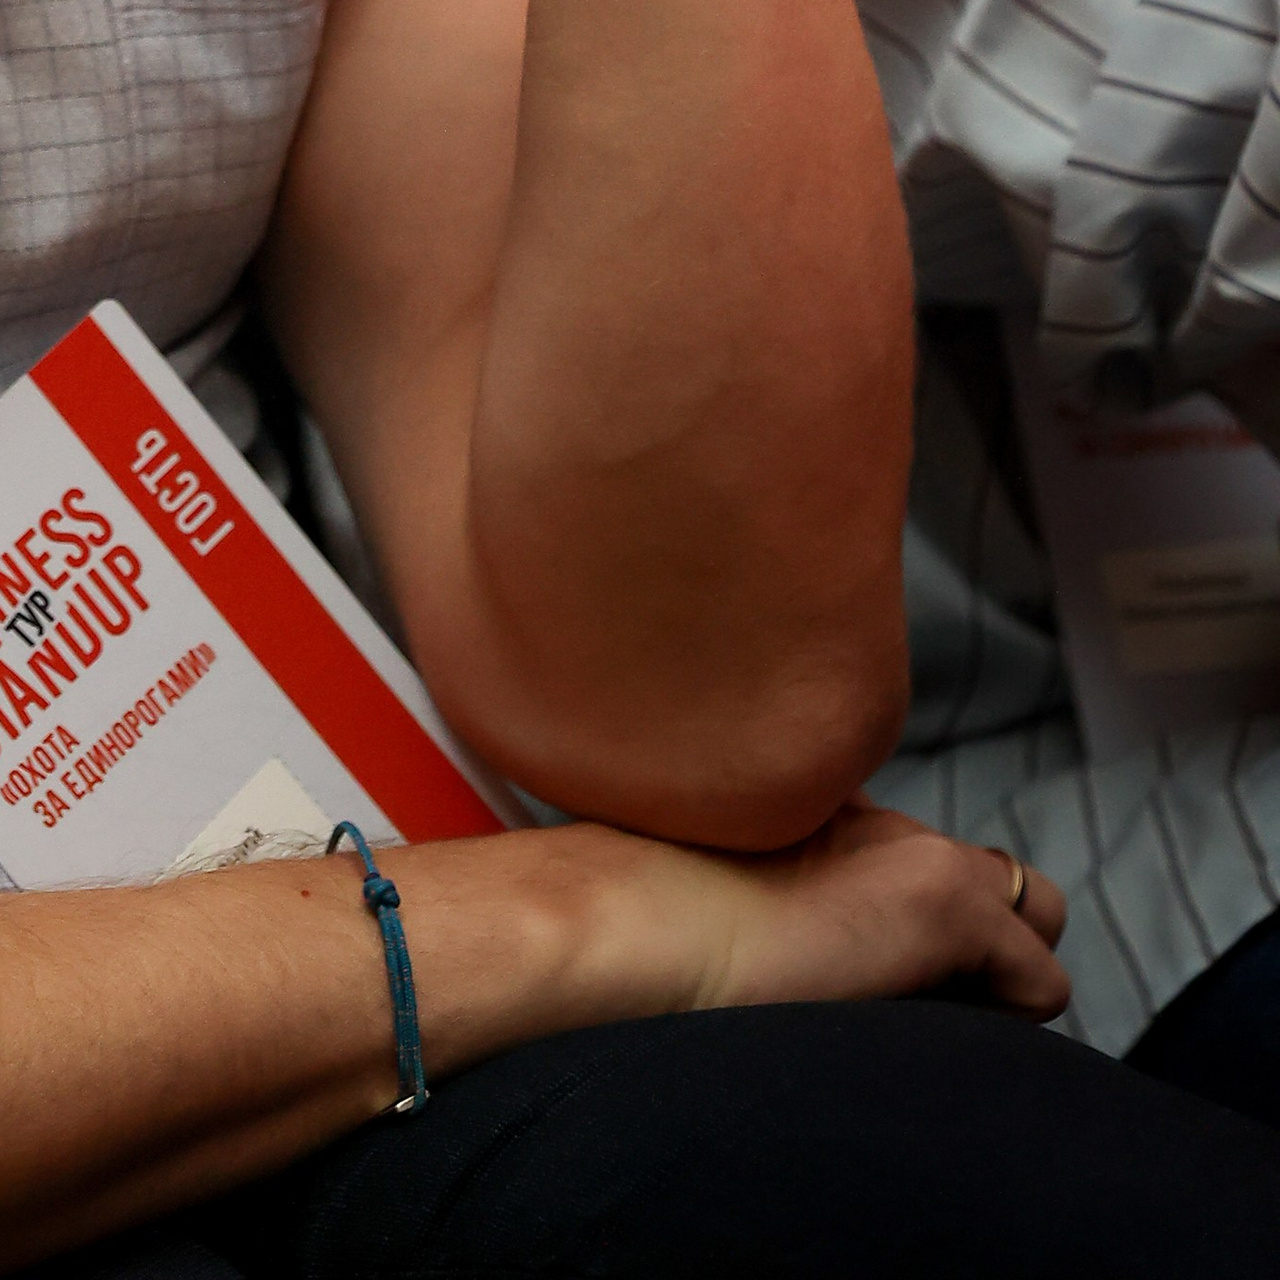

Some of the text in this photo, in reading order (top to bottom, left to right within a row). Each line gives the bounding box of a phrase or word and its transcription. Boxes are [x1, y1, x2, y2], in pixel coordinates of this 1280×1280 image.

[130, 428, 235, 556] ГОСТЬ
[0, 724, 80, 806] «ОХОТА
[33, 643, 217, 828] ЗА ЕДИНОРОГАМИ»
